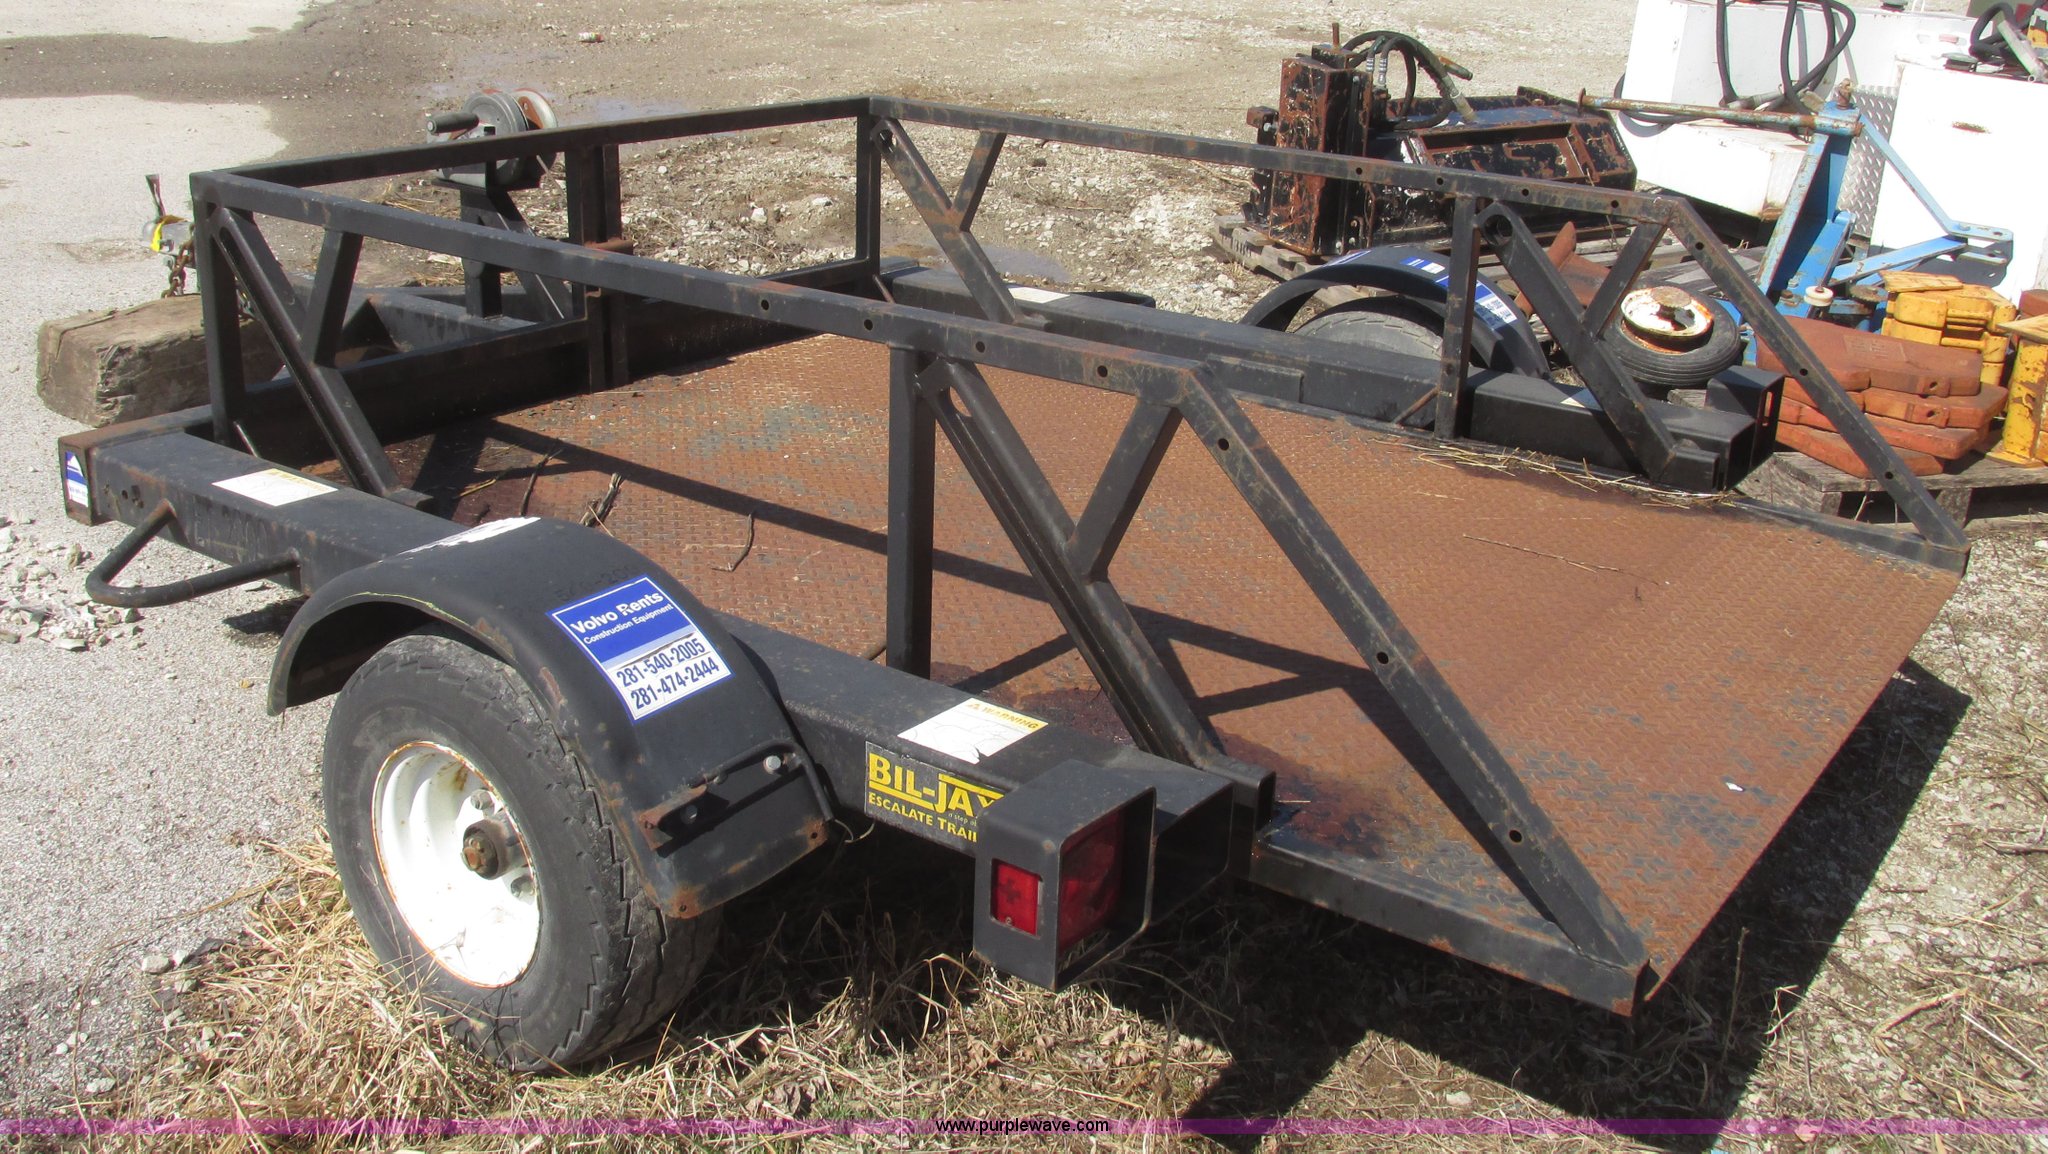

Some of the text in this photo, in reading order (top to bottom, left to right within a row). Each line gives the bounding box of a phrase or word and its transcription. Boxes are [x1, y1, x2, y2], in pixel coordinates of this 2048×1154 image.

[570, 592, 664, 634] Volvo Rents
[583, 603, 674, 645] Construction Equipment
[616, 638, 706, 687] 281-540-2005
[630, 656, 719, 710] 281-474-2444
[868, 792, 934, 826] ESCALATE
